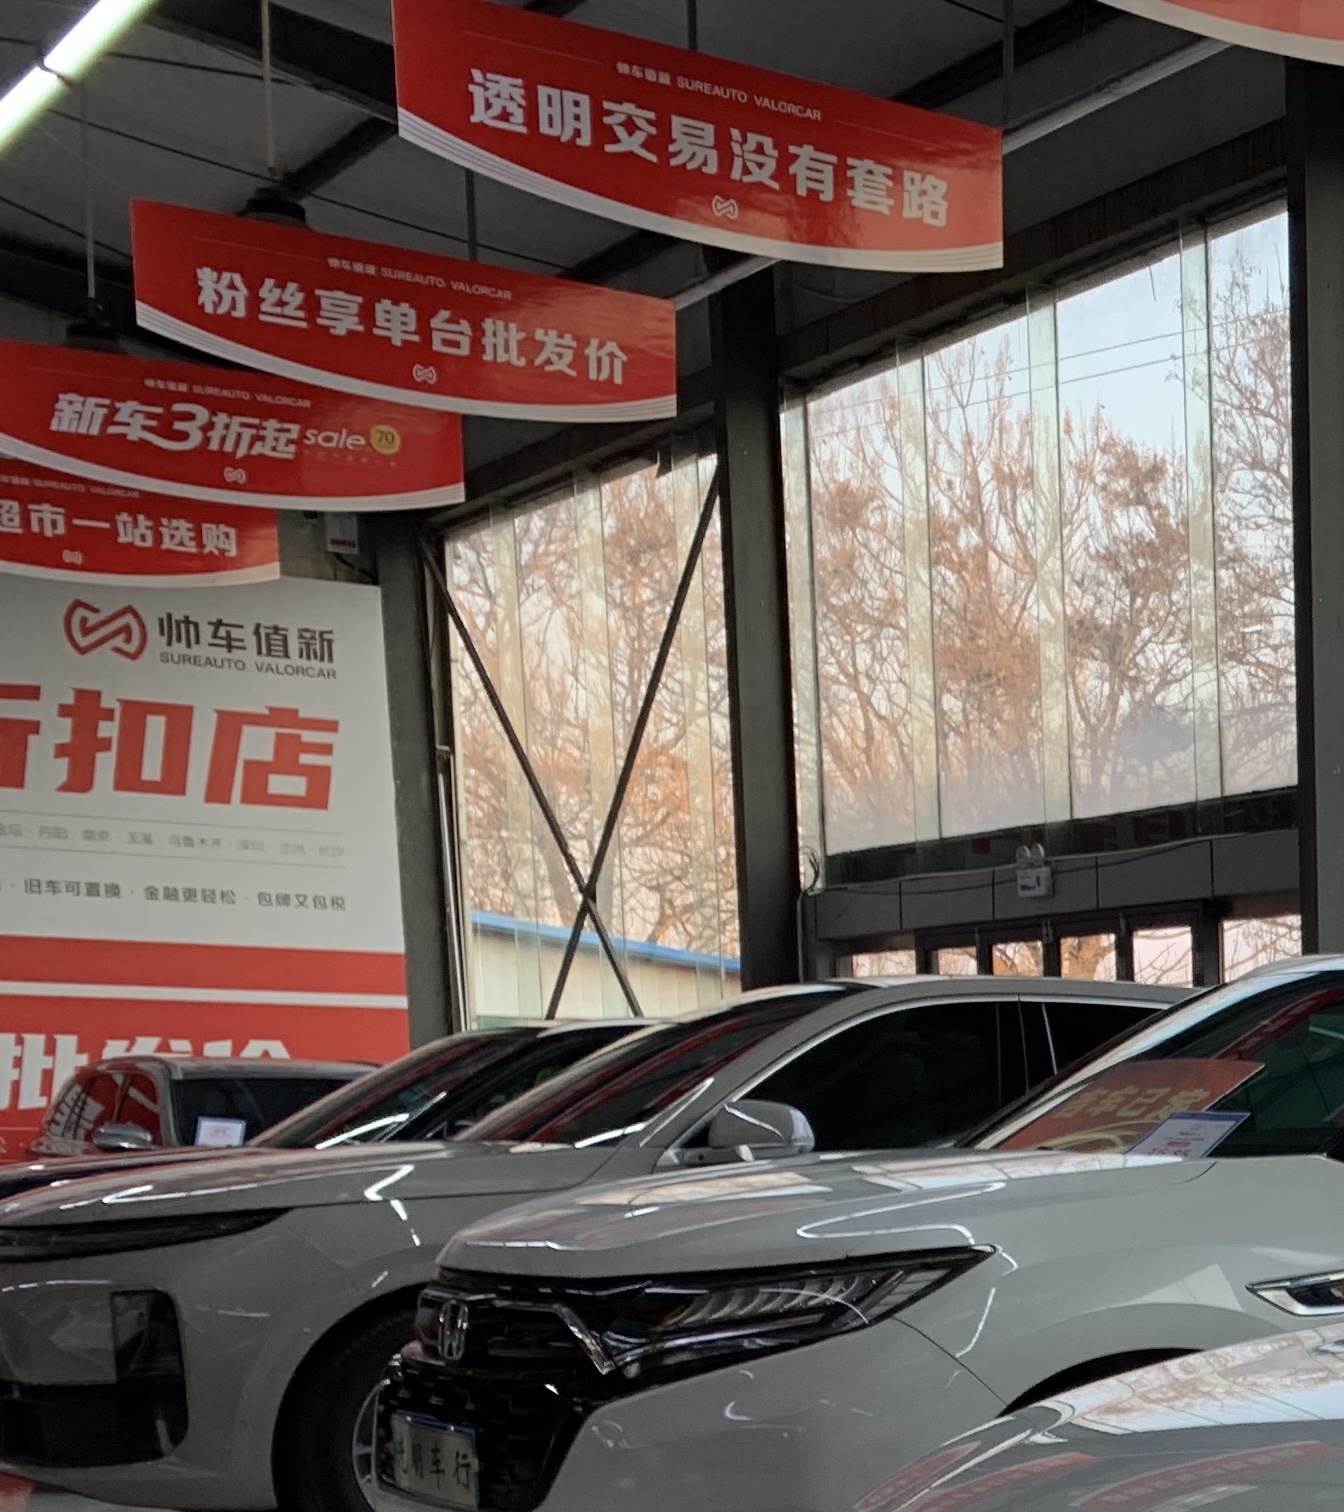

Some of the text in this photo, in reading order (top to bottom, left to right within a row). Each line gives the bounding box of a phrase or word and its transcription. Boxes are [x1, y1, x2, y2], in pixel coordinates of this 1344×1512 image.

[676, 75, 748, 103] SUREAUTO
[753, 95, 822, 122] VALORCAR
[468, 67, 949, 228] 透明交易没有套路
[196, 266, 628, 386] 粉丝享单台批发价
[49, 392, 302, 460] 新车3折起
[302, 427, 366, 452] sale
[157, 612, 335, 664] 帅车值新
[159, 652, 337, 680] SUREAUTO VALORCAR
